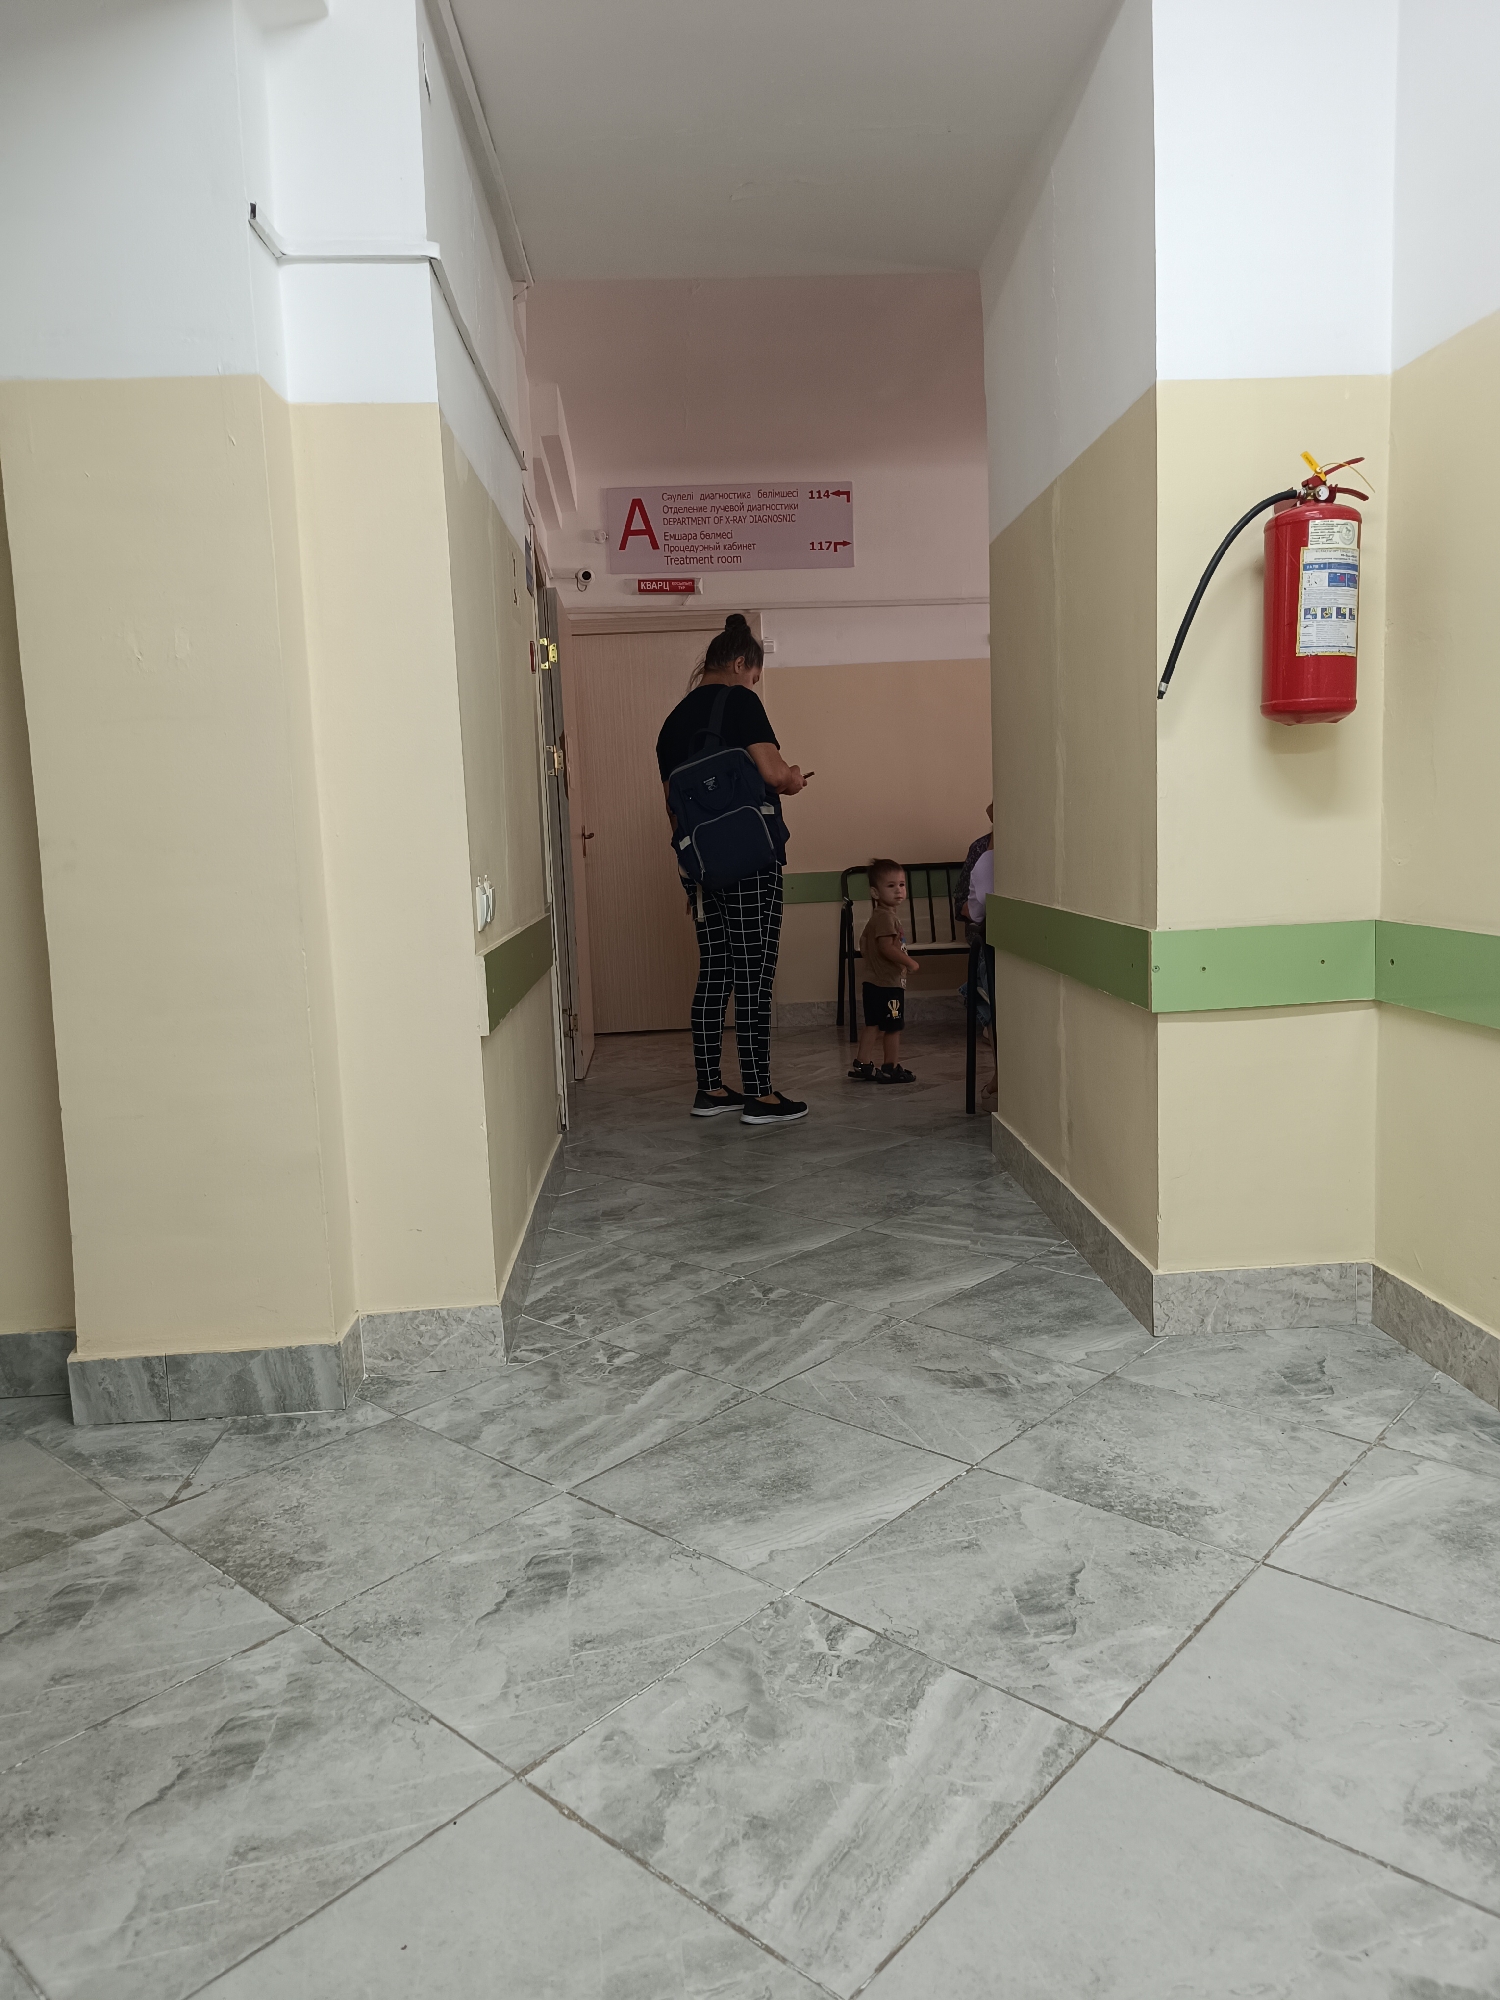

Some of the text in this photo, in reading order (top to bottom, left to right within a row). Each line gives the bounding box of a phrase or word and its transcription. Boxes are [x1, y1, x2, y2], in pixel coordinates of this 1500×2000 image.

[699, 491, 751, 501] диагностика
[757, 489, 799, 499] бөлімшесі
[808, 489, 831, 500] 114
[662, 502, 799, 515] Отделение лучевой диагностики
[662, 516, 712, 526] DEPARTMENT
[713, 515, 724, 525] OF
[725, 515, 747, 525] X-RAY
[663, 530, 733, 542] Емшара бөлмесі
[663, 541, 833, 554] Процедурный кабинет 117
[664, 555, 742, 566] Treatment room
[640, 581, 670, 592] КВАРЦ
